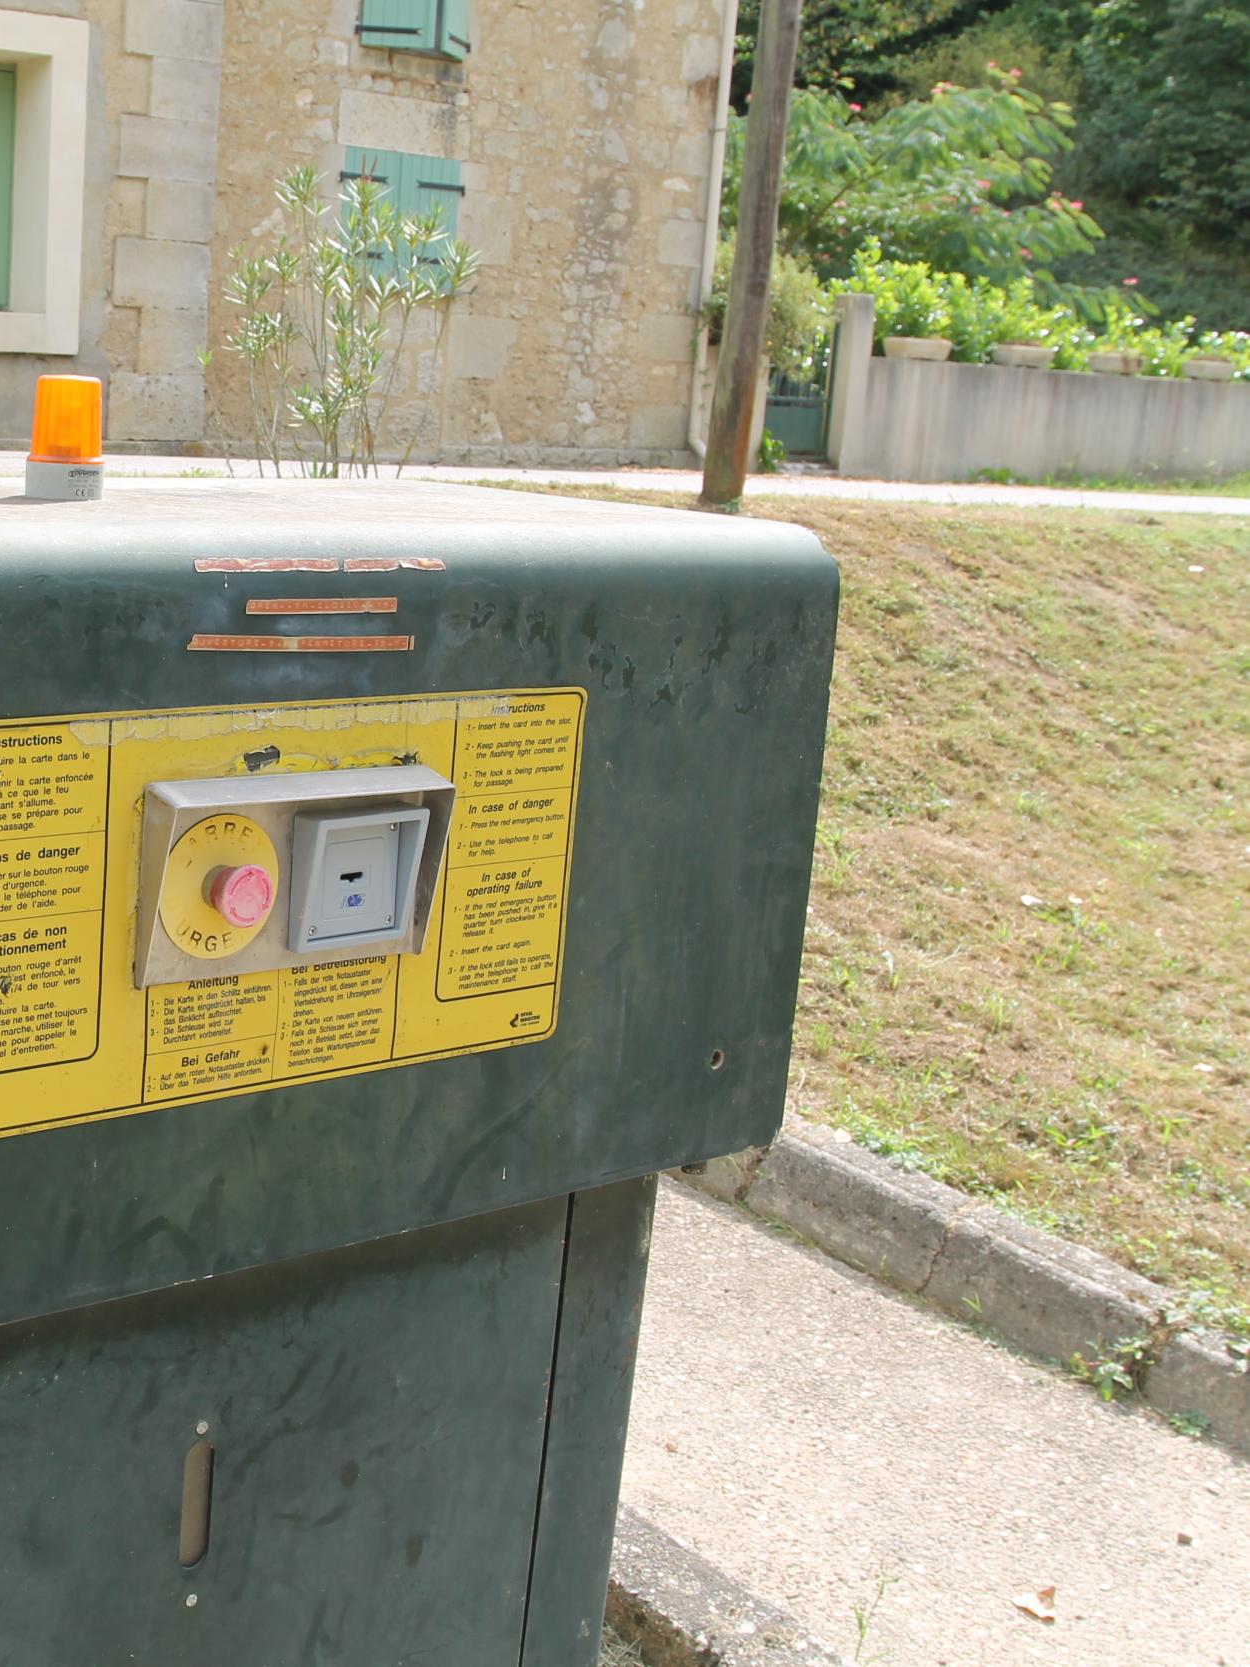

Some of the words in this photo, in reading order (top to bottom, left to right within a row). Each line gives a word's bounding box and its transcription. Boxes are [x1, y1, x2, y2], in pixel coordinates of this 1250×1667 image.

[18, 756, 26, 764] la
[30, 754, 53, 763] carte
[57, 753, 78, 762] dans
[82, 752, 90, 760] le
[16, 778, 24, 786] la
[28, 776, 50, 785] carte
[54, 773, 93, 783] enfoncée
[22, 789, 39, 799] que
[43, 787, 51, 795] le
[55, 786, 69, 794] feu
[26, 809, 59, 820] prépare
[63, 807, 83, 817] pour
[468, 805, 477, 815] In
[481, 804, 504, 813] case
[507, 801, 518, 811] of
[521, 800, 553, 810] danger
[15, 851, 31, 861] de
[37, 847, 80, 860] danger
[7, 871, 21, 879] sur
[23, 869, 31, 877] le
[33, 867, 62, 876] bouton
[64, 865, 89, 874] rouge
[482, 873, 490, 882] In
[494, 871, 517, 881] case
[520, 868, 531, 878] of
[3, 893, 11, 901] le
[61, 887, 81, 897] pour
[467, 884, 510, 898] operating
[514, 880, 543, 891] failure
[16, 902, 27, 911] de
[22, 928, 38, 940] de
[44, 926, 67, 937] non
[25, 961, 50, 970] rouge
[54, 956, 81, 967] d'arrêt
[13, 972, 26, 982] est
[67, 967, 75, 975] le
[26, 981, 38, 991] de
[42, 980, 58, 989] tour
[63, 978, 81, 986] vers
[21, 1005, 29, 1013] la
[36, 1011, 52, 1021] met
[54, 1007, 87, 1018] toujours
[35, 1021, 63, 1031] utiliser
[67, 1019, 74, 1027] le
[11, 1036, 30, 1047] pour
[34, 1031, 65, 1043] appeler
[69, 1028, 77, 1037] le
[181, 1055, 199, 1067] Bei
[204, 1049, 240, 1064] Gefahr
